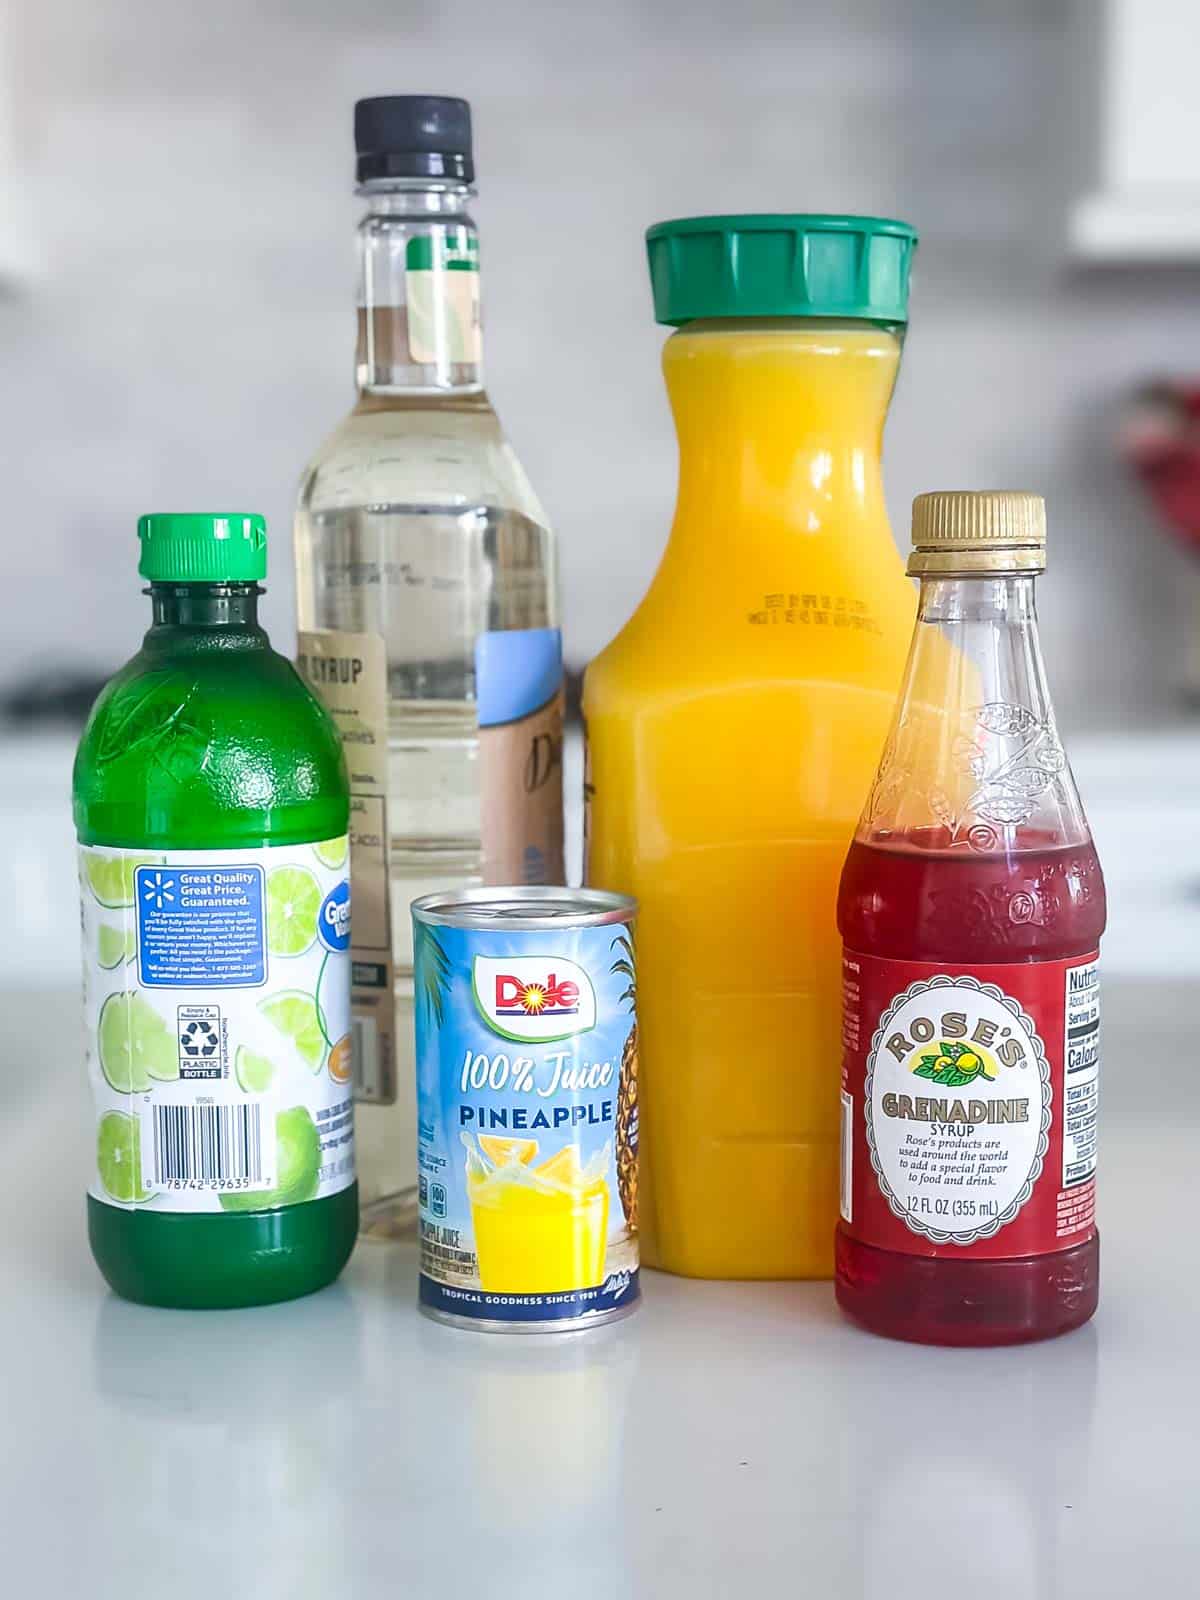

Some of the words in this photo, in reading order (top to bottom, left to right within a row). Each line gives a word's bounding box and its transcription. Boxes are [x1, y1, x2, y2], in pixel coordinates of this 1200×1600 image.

[313, 659, 362, 684] SYRUP
[180, 873, 211, 884] Great
[213, 873, 257, 887] Quality.
[180, 885, 211, 895] Great
[214, 884, 245, 895] Price.
[181, 896, 250, 907] Guaranteed.
[496, 973, 580, 1011] Dole
[1069, 1011, 1089, 1025] Serving
[886, 1012, 1026, 1068] ROSE'S
[184, 1070, 217, 1078] BOTTLE
[461, 1049, 534, 1093] 100%
[537, 1050, 614, 1097] Juice
[1067, 1088, 1081, 1100] Total
[460, 1100, 612, 1129] PINEAPPLE
[882, 1092, 1030, 1124] GRENADINE
[1067, 1103, 1088, 1116] Sodium
[930, 1124, 975, 1137] SYRUP
[1067, 1119, 1081, 1131] Total
[905, 1135, 936, 1148] Rose's
[938, 1139, 982, 1150] products
[985, 1140, 1001, 1149] are
[899, 1147, 919, 1158] used
[921, 1149, 958, 1160] around
[960, 1149, 977, 1160] the
[979, 1149, 1009, 1161] world
[899, 1160, 908, 1169] to
[910, 1160, 928, 1171] add
[939, 1162, 974, 1175] special
[977, 1162, 1008, 1174] flavor
[167, 1180, 204, 1190] 78742
[211, 1179, 249, 1190] 29635
[909, 1174, 918, 1182] to
[918, 1173, 942, 1186] food
[944, 1174, 964, 1185] and
[966, 1174, 997, 1186] drink.
[907, 1196, 919, 1212] 12
[922, 1197, 933, 1214] FL
[935, 1198, 950, 1215] OZ
[952, 1199, 976, 1217] (355
[979, 1200, 999, 1217] mL)
[442, 1288, 482, 1304] TROPICAL
[486, 1295, 542, 1305] GOODNESS
[546, 1294, 576, 1304] SINCE
